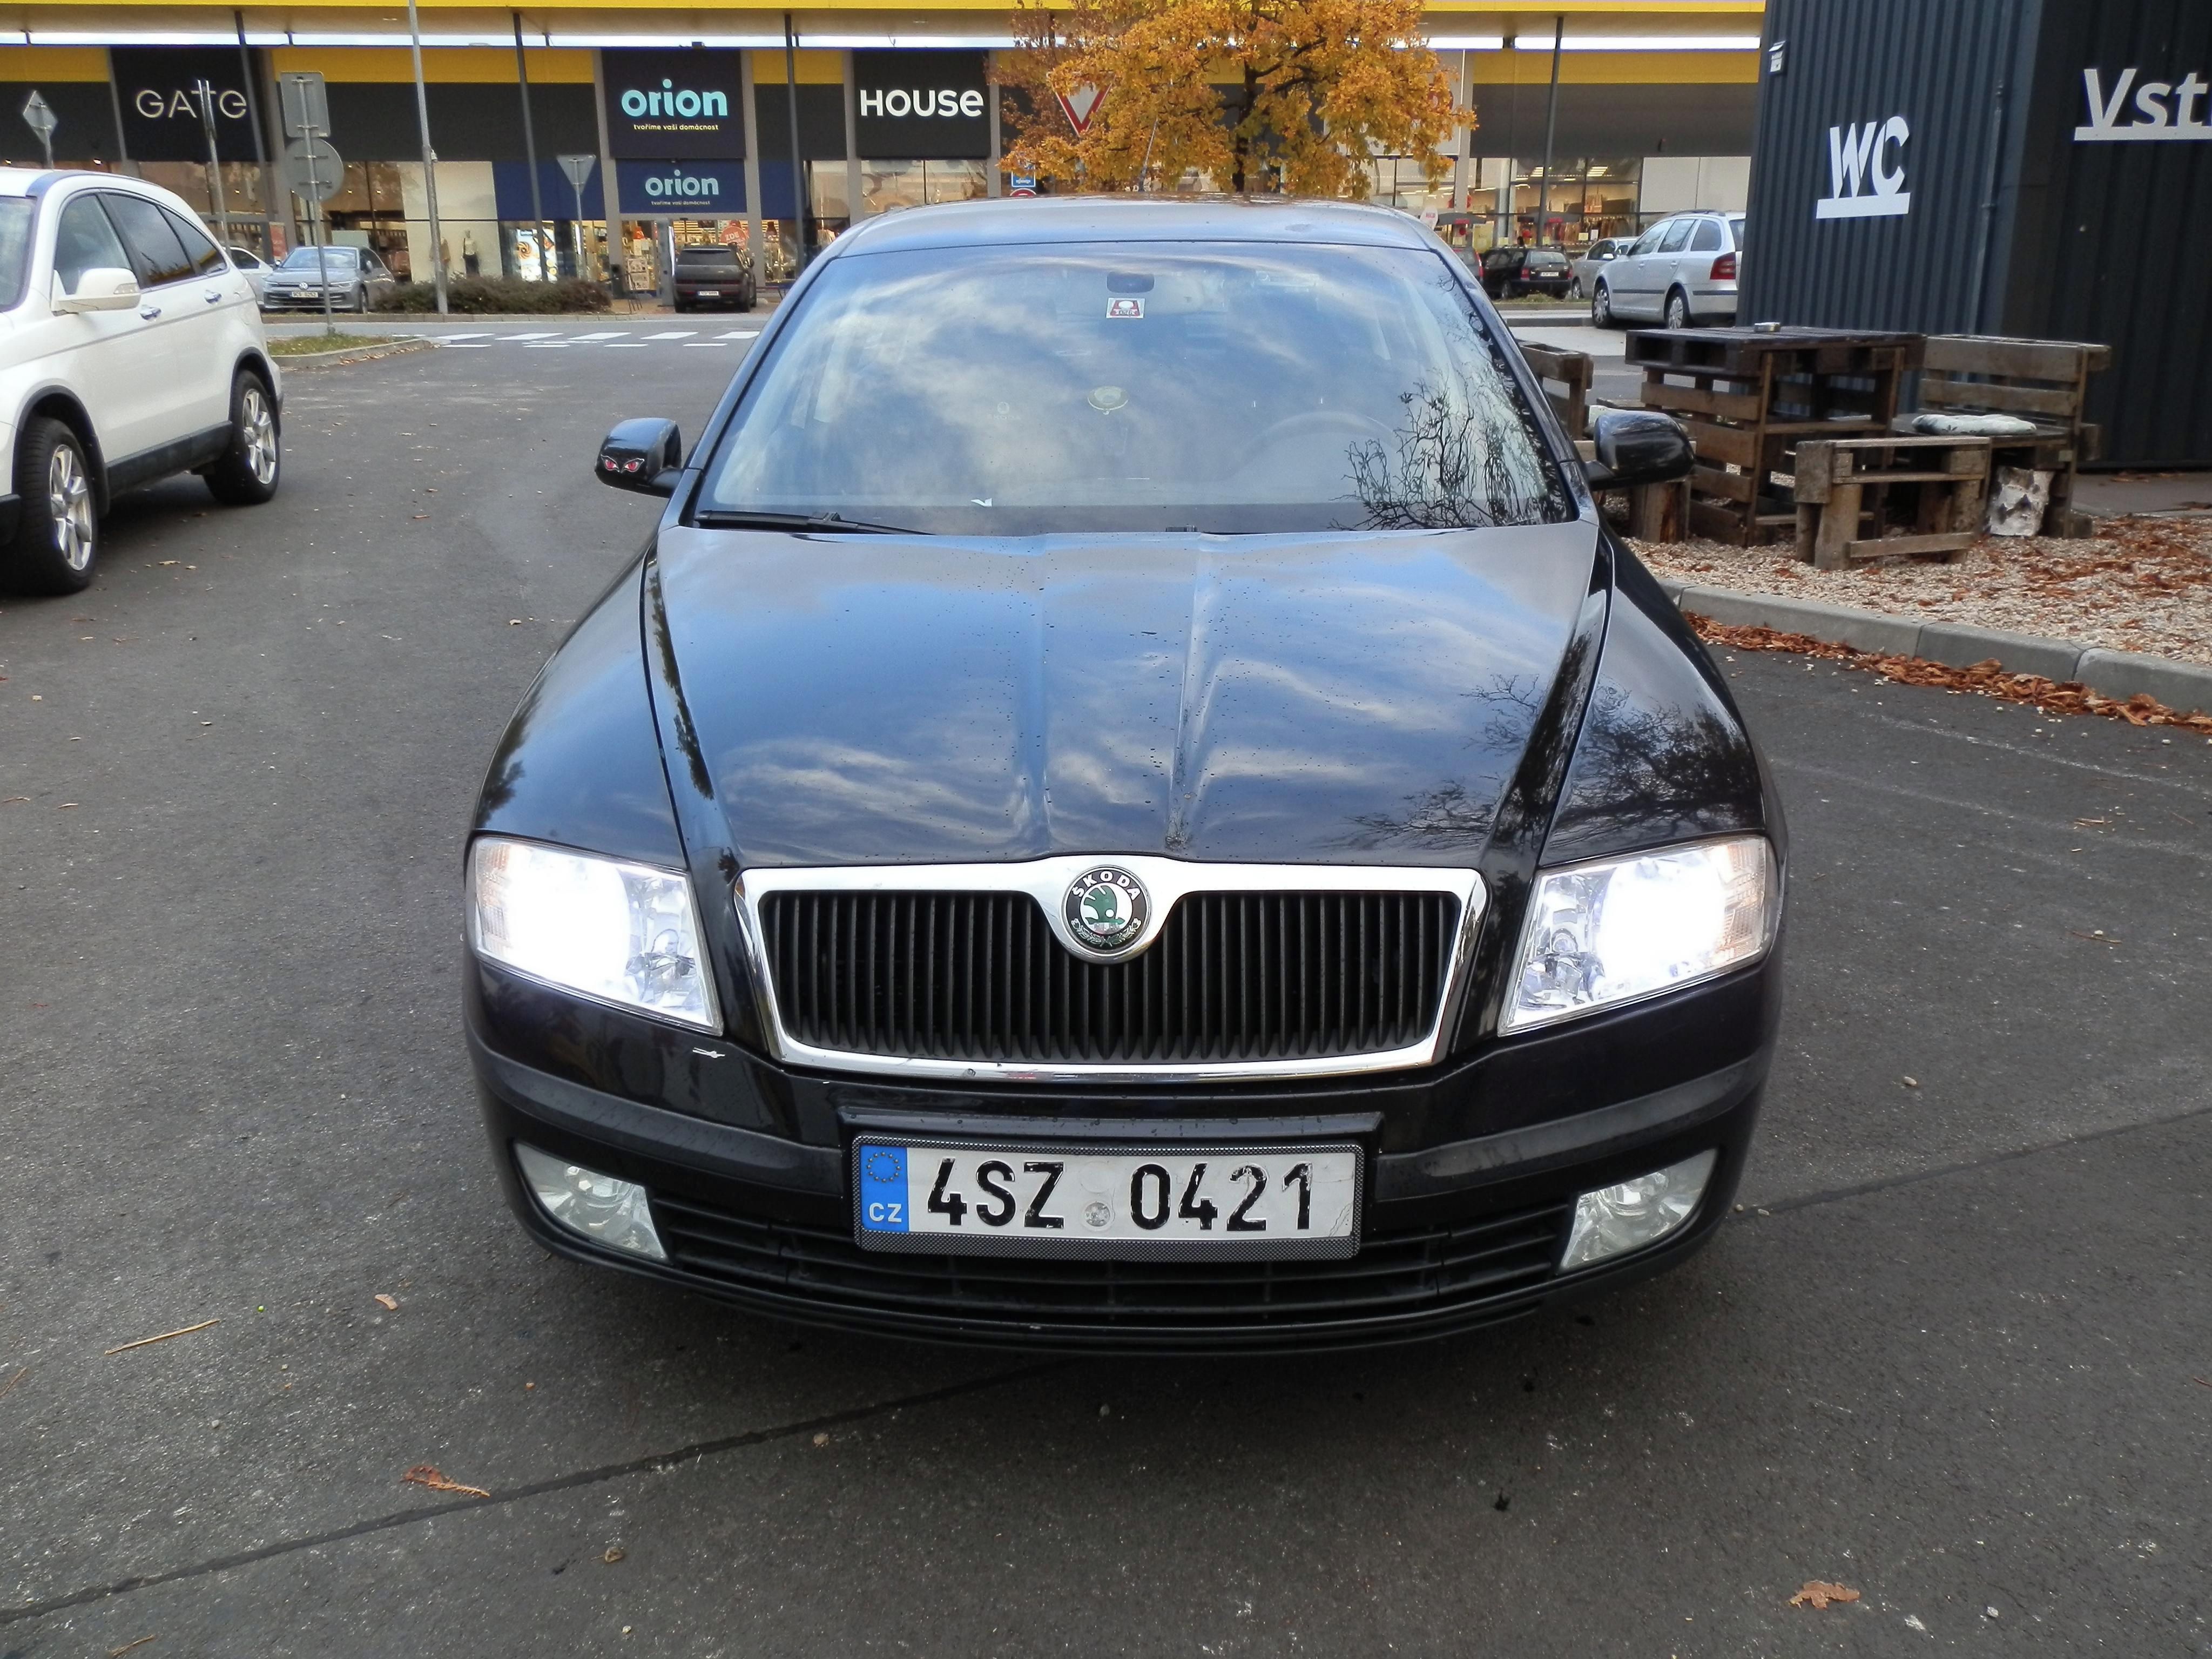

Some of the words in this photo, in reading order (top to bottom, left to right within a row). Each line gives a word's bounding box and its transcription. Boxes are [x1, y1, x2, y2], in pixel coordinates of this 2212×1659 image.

[622, 78, 728, 117] orion
[2082, 68, 2212, 131] Vst
[1829, 116, 1910, 201] WC
[645, 169, 719, 196] orion
[1071, 870, 1142, 901] ŠKODA
[868, 1202, 902, 1223] CZ
[927, 1157, 1064, 1229] 4SZ
[1129, 1162, 1313, 1232] 0421
